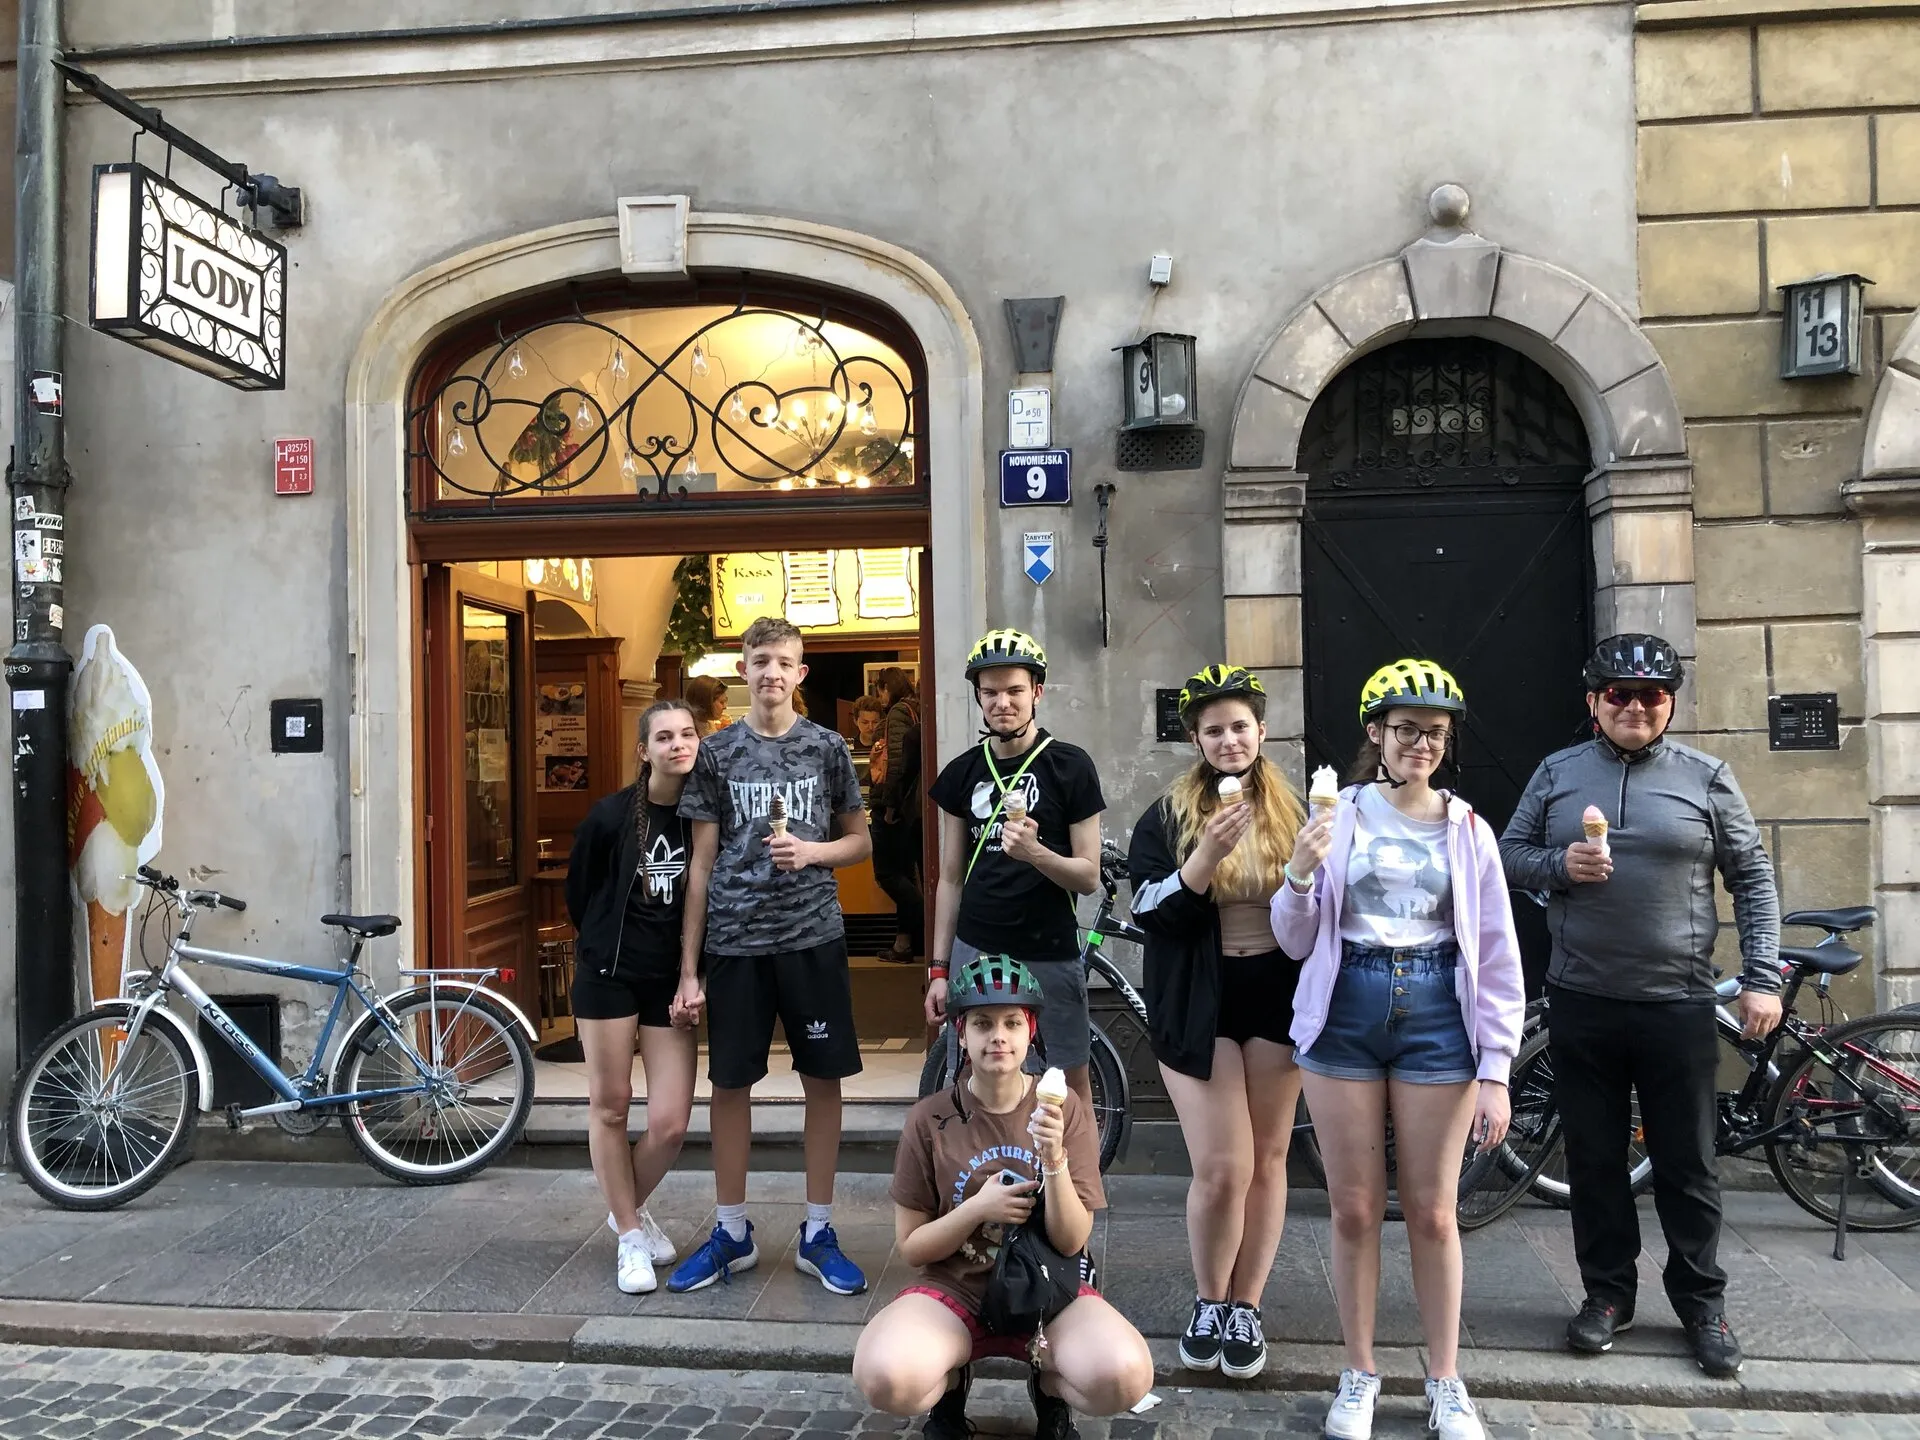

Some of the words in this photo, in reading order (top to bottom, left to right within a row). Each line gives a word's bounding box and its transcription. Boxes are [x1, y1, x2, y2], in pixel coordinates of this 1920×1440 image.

[172, 244, 255, 318] LODY
[1805, 322, 1839, 357] 13
[1139, 361, 1150, 394] 9
[1012, 398, 1024, 415] D
[277, 446, 288, 462] H
[287, 443, 308, 453] 32575
[1009, 455, 1063, 467] NOWOMIEJSKA
[1026, 466, 1047, 499] 9
[952, 1170, 972, 1208] RAL
[969, 1145, 1034, 1170] NATURE
